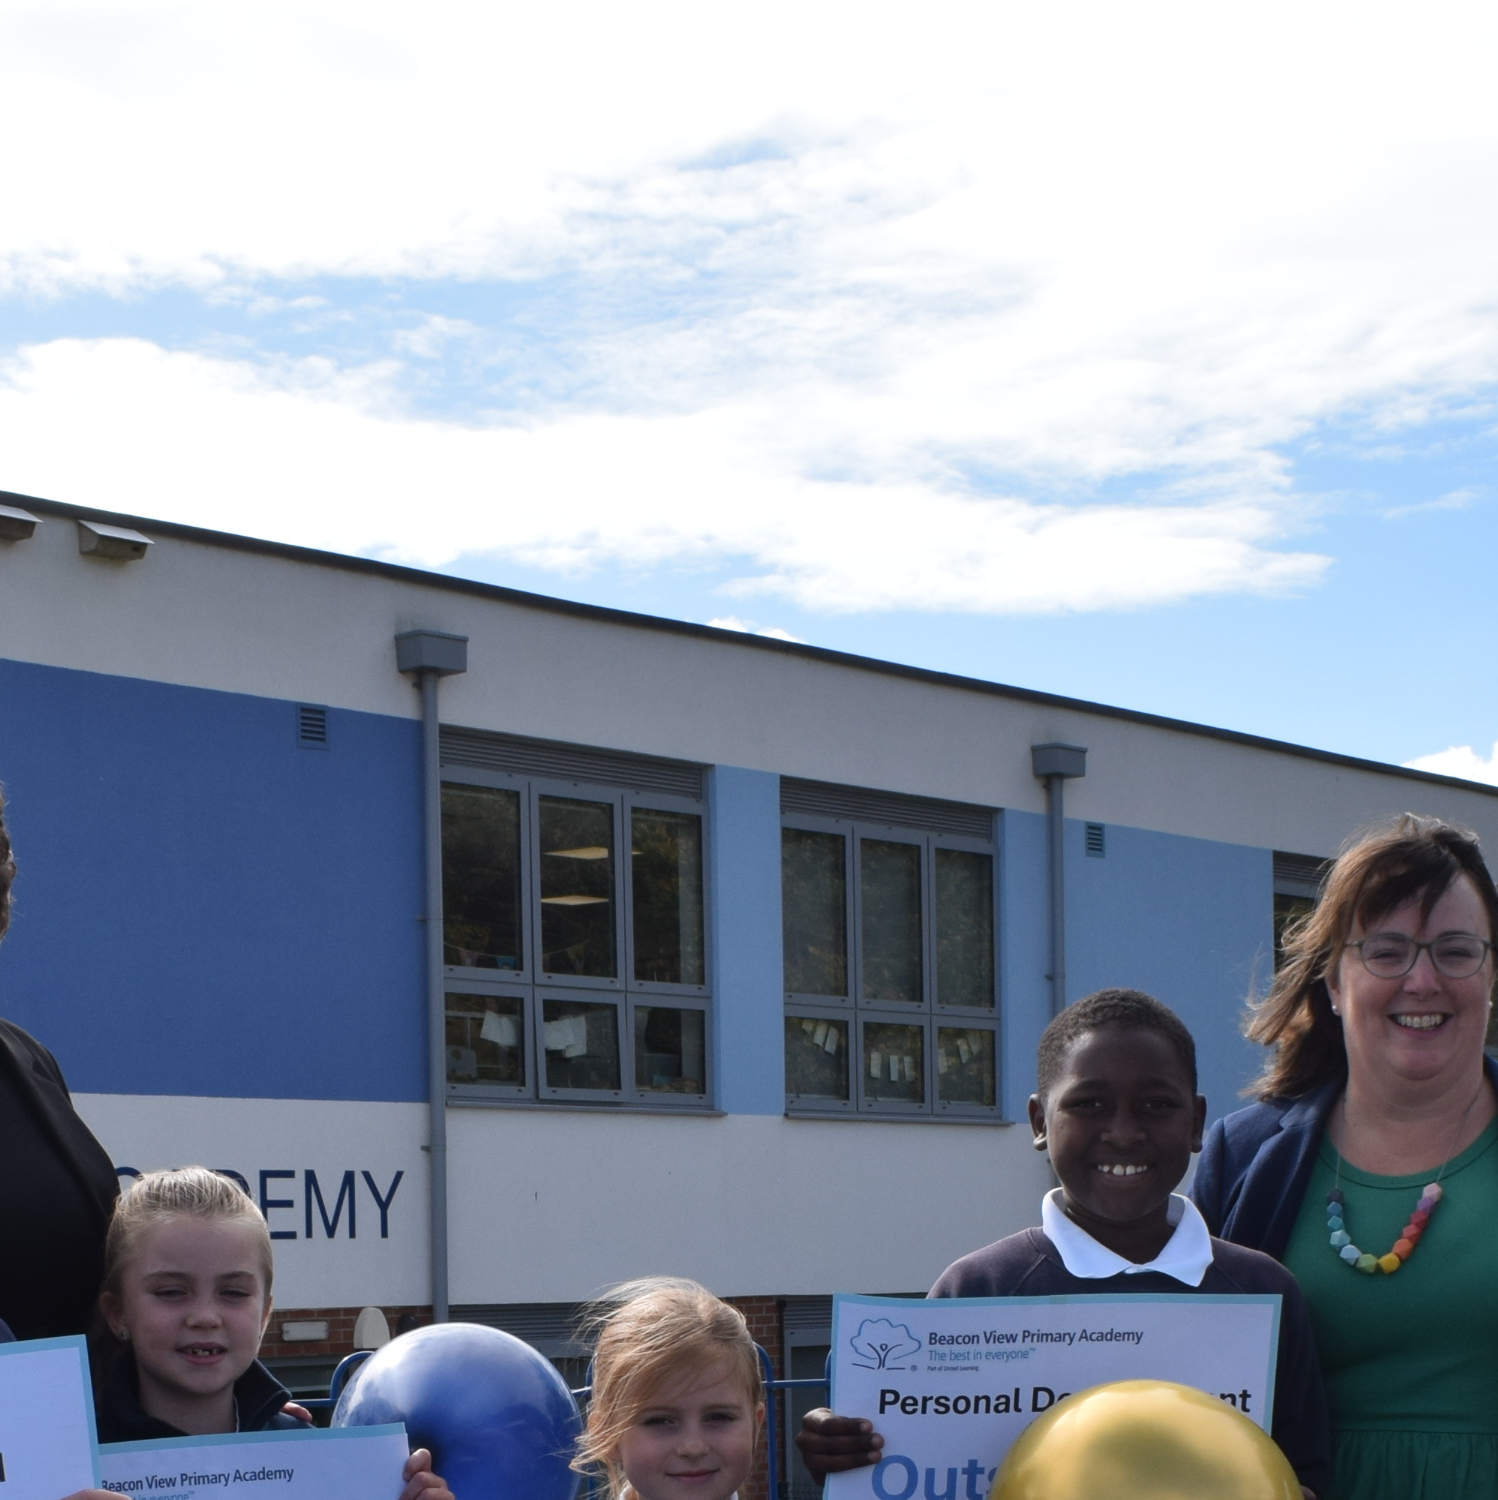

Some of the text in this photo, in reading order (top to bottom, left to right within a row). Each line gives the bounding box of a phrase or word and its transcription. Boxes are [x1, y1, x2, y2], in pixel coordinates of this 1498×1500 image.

[928, 1327, 1144, 1346] Beacon View Primary Academy
[928, 1350, 947, 1362] The
[949, 1349, 970, 1361] best
[973, 1348, 982, 1361] in
[879, 1387, 1022, 1415] Personal
[145, 1475, 177, 1490] View
[180, 1472, 230, 1487] Primary
[233, 1466, 295, 1483] Academy
